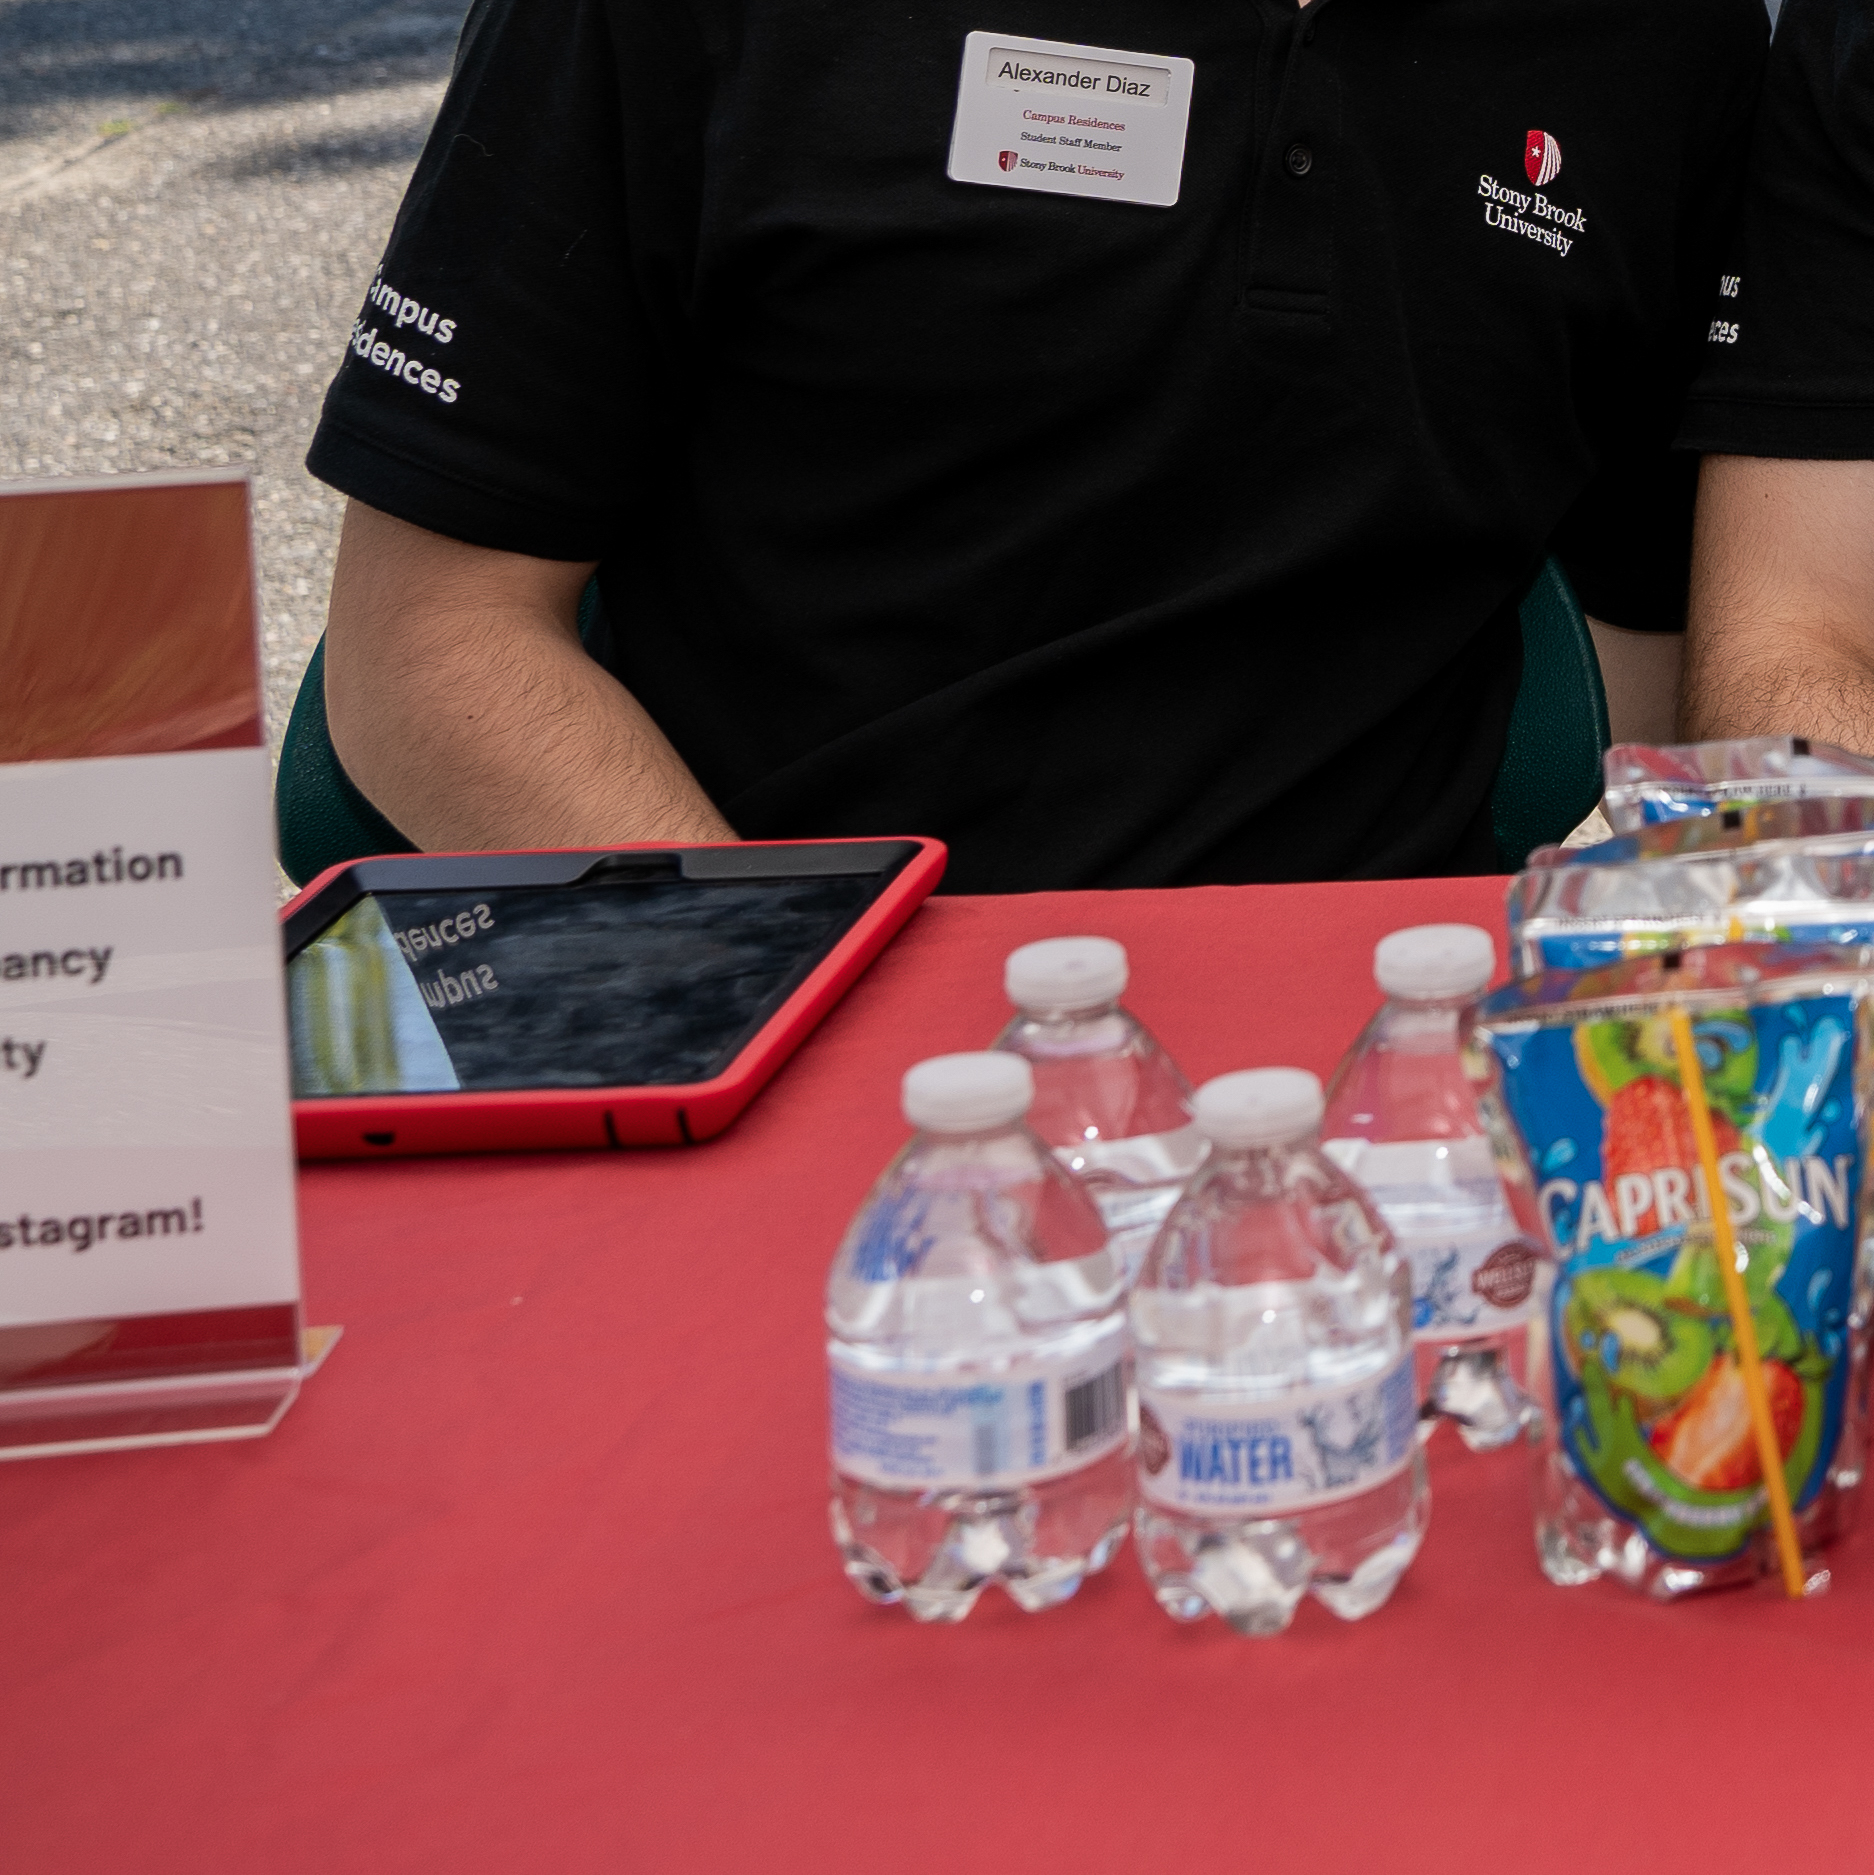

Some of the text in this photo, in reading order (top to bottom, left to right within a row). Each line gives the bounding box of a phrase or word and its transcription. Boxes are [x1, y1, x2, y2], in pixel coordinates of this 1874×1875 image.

[998, 61, 1151, 97] Alexander Diaz
[1023, 109, 1126, 132] Campus Residences
[1020, 131, 1122, 152] Student Staff Member
[1020, 157, 1125, 181] Stony Brook University
[1477, 174, 1588, 233] Stony Brook
[1484, 202, 1573, 258] University
[1180, 1435, 1295, 1484] WATER
